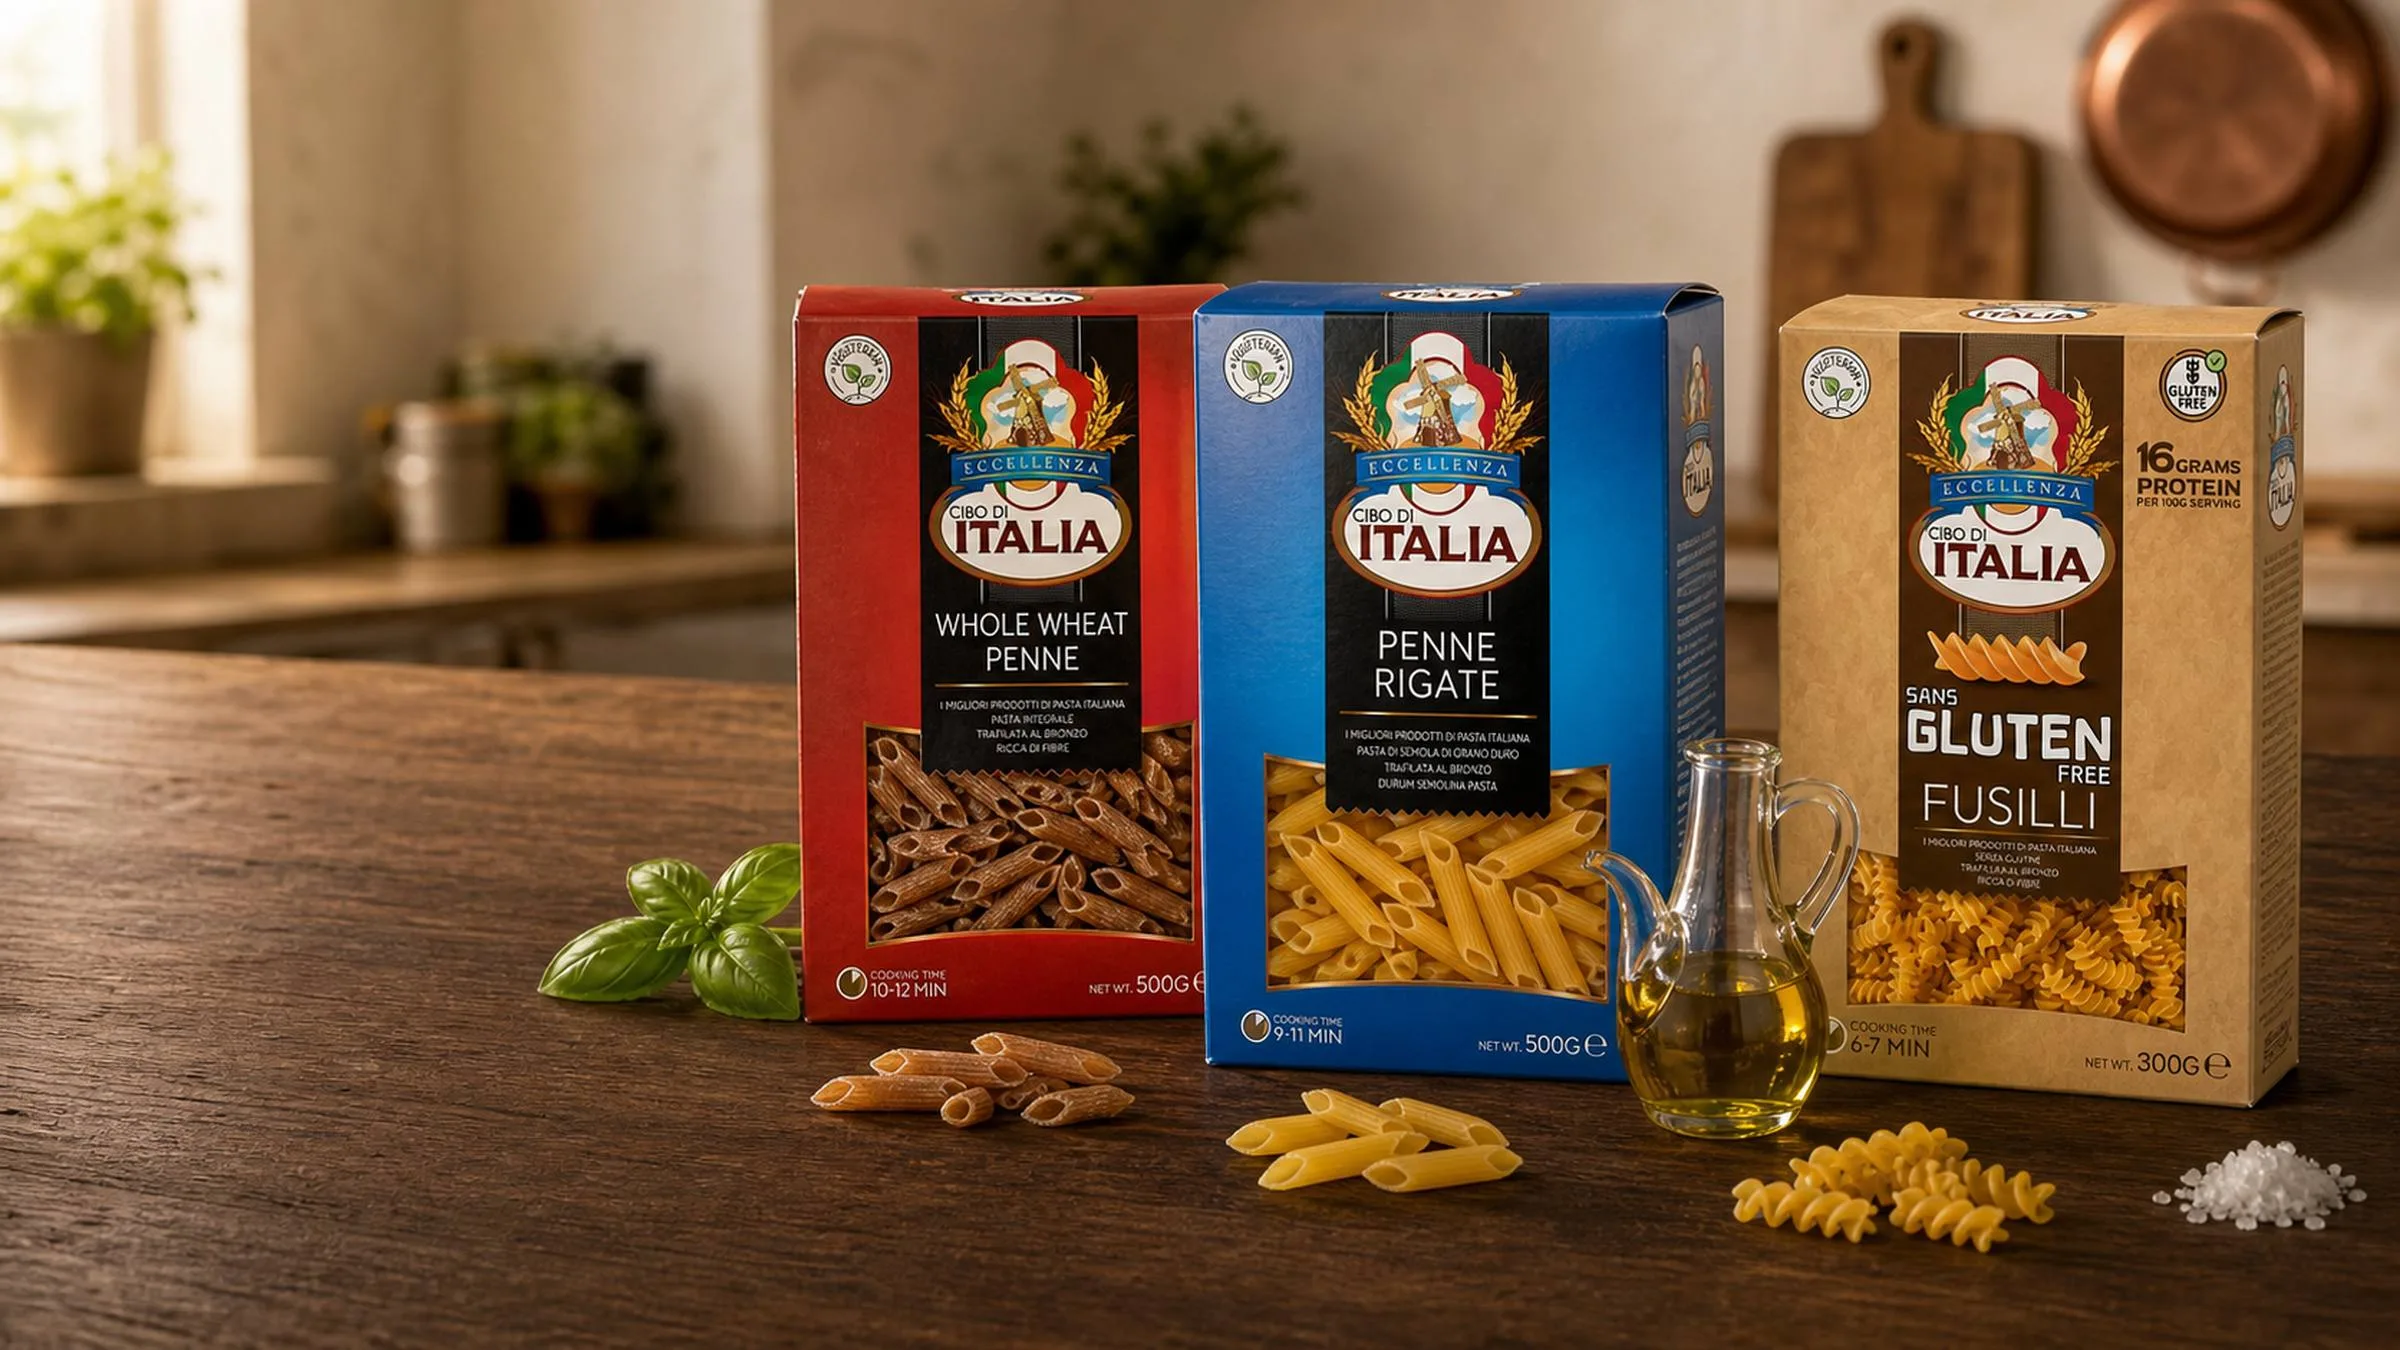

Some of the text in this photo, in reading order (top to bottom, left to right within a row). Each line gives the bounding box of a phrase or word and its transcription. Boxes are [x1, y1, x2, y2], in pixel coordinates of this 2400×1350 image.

[1975, 311, 2075, 320] ITALIA
[2168, 385, 2217, 398] GLUTEN
[2178, 398, 2207, 410] FREE
[963, 456, 1099, 475] ECCELLENZA
[1368, 456, 1508, 477] ECCELLENZA
[2136, 441, 2241, 474] 16 GRAMS
[1943, 478, 2081, 500] ECCELLENZA
[2137, 478, 2241, 496] PROTEIN
[949, 505, 1008, 519] CIBO DI
[2137, 497, 2241, 509] PER 100G SERVING
[1353, 508, 1414, 523] CIBO DI
[955, 519, 1109, 555] ITALIA
[1359, 524, 1519, 563] ITALIA
[1928, 526, 1987, 542] CIBO DI
[1934, 542, 2091, 583] ITALIA
[935, 611, 1129, 637] WHOLE WHEAT
[1378, 630, 1496, 662] PENNE
[986, 645, 1080, 671] PENNE
[1375, 668, 1500, 700] RIGATE
[1905, 686, 1958, 706] SANS
[1030, 729, 1042, 739] AL
[1457, 731, 1487, 743] PASTA
[1488, 732, 1531, 744] ITALIANA
[1906, 708, 2111, 762] GLUTEN
[1441, 747, 1452, 758] DI
[1436, 763, 1448, 774] AL
[2058, 764, 2111, 785] FREE
[1467, 780, 1498, 792] PASTA
[1924, 783, 2095, 830] FUSILLI
[871, 981, 947, 998] 10-12 MIN
[1089, 984, 1110, 994] NET
[1136, 974, 1190, 994] 500G
[1273, 1026, 1342, 1044] 9-11 MIN
[1850, 1020, 1937, 1037] COOKING TIME
[1478, 1040, 1500, 1051] NET
[1525, 1034, 1580, 1055] 500G
[1850, 1035, 1930, 1057] 6-7 MIN
[2085, 1057, 2109, 1069] NET
[2137, 1052, 2200, 1076] 300G
